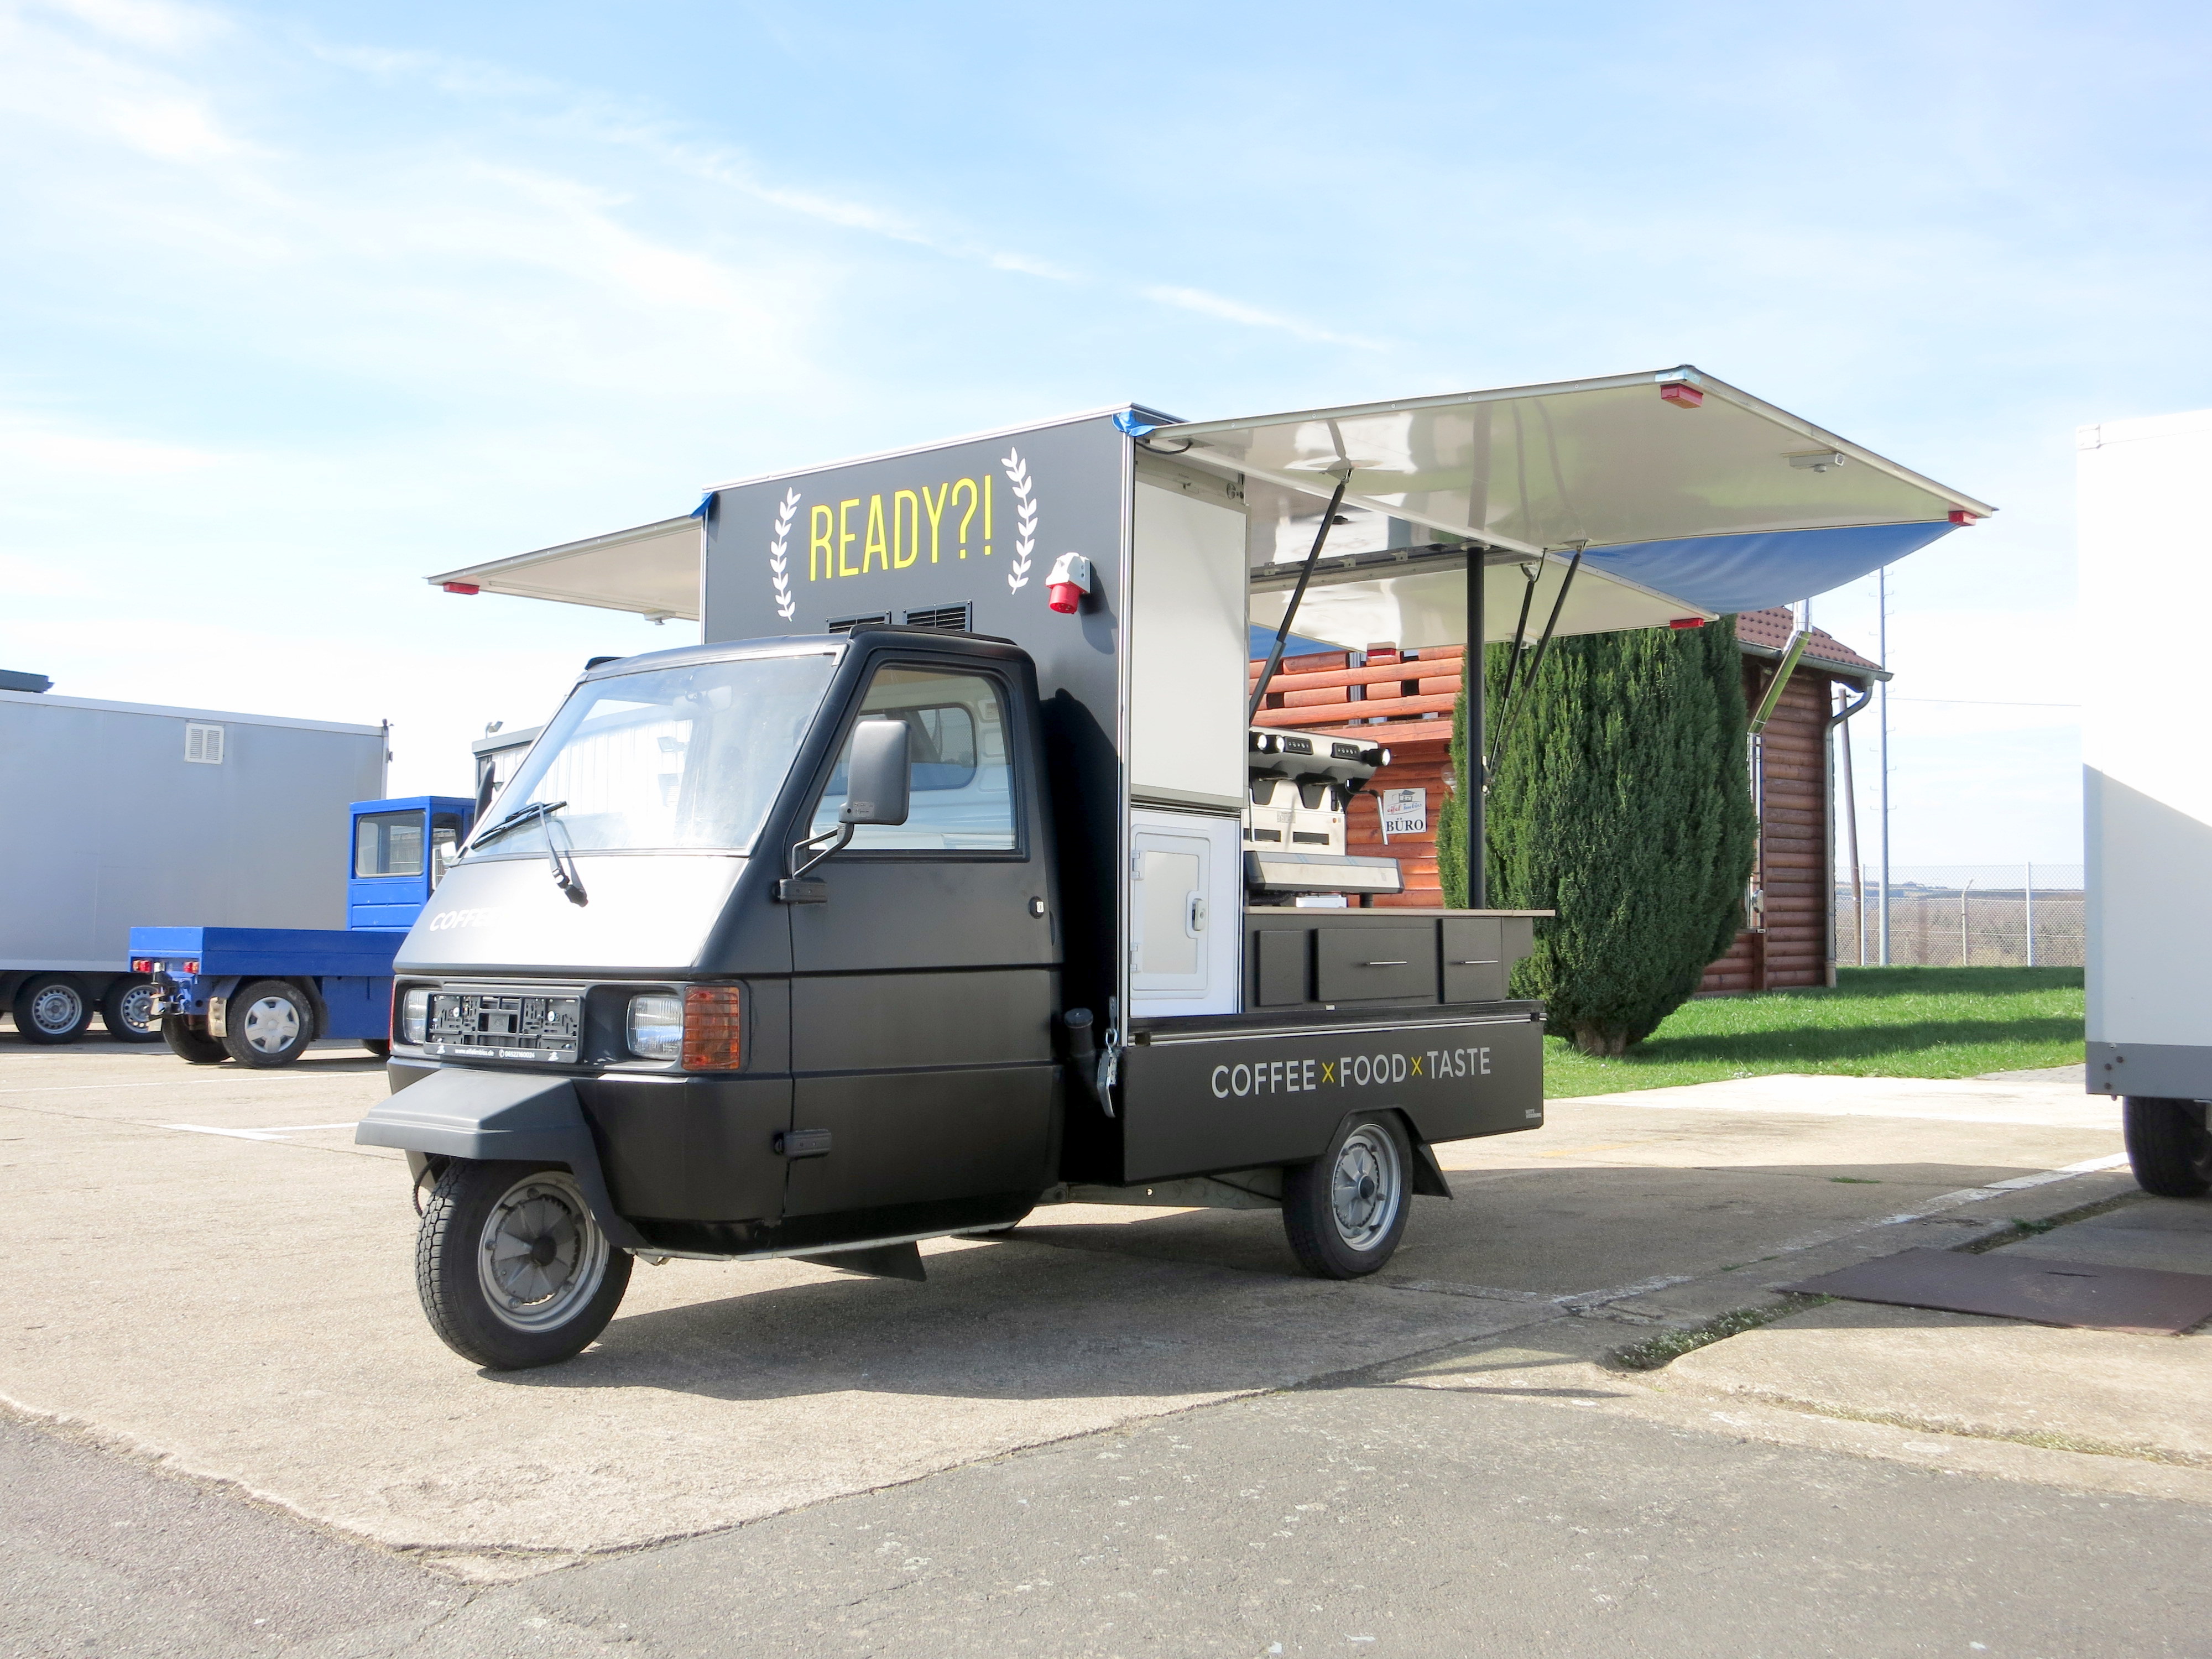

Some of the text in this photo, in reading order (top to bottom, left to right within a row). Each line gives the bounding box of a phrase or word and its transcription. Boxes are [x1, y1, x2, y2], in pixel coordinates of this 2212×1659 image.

[810, 474, 993, 582] READY?!
[1386, 817, 1423, 832] BÜRO
[1211, 1059, 1316, 1099] COFFEE
[1340, 1053, 1407, 1088] FOOD
[1426, 1047, 1491, 1080] TASTE
